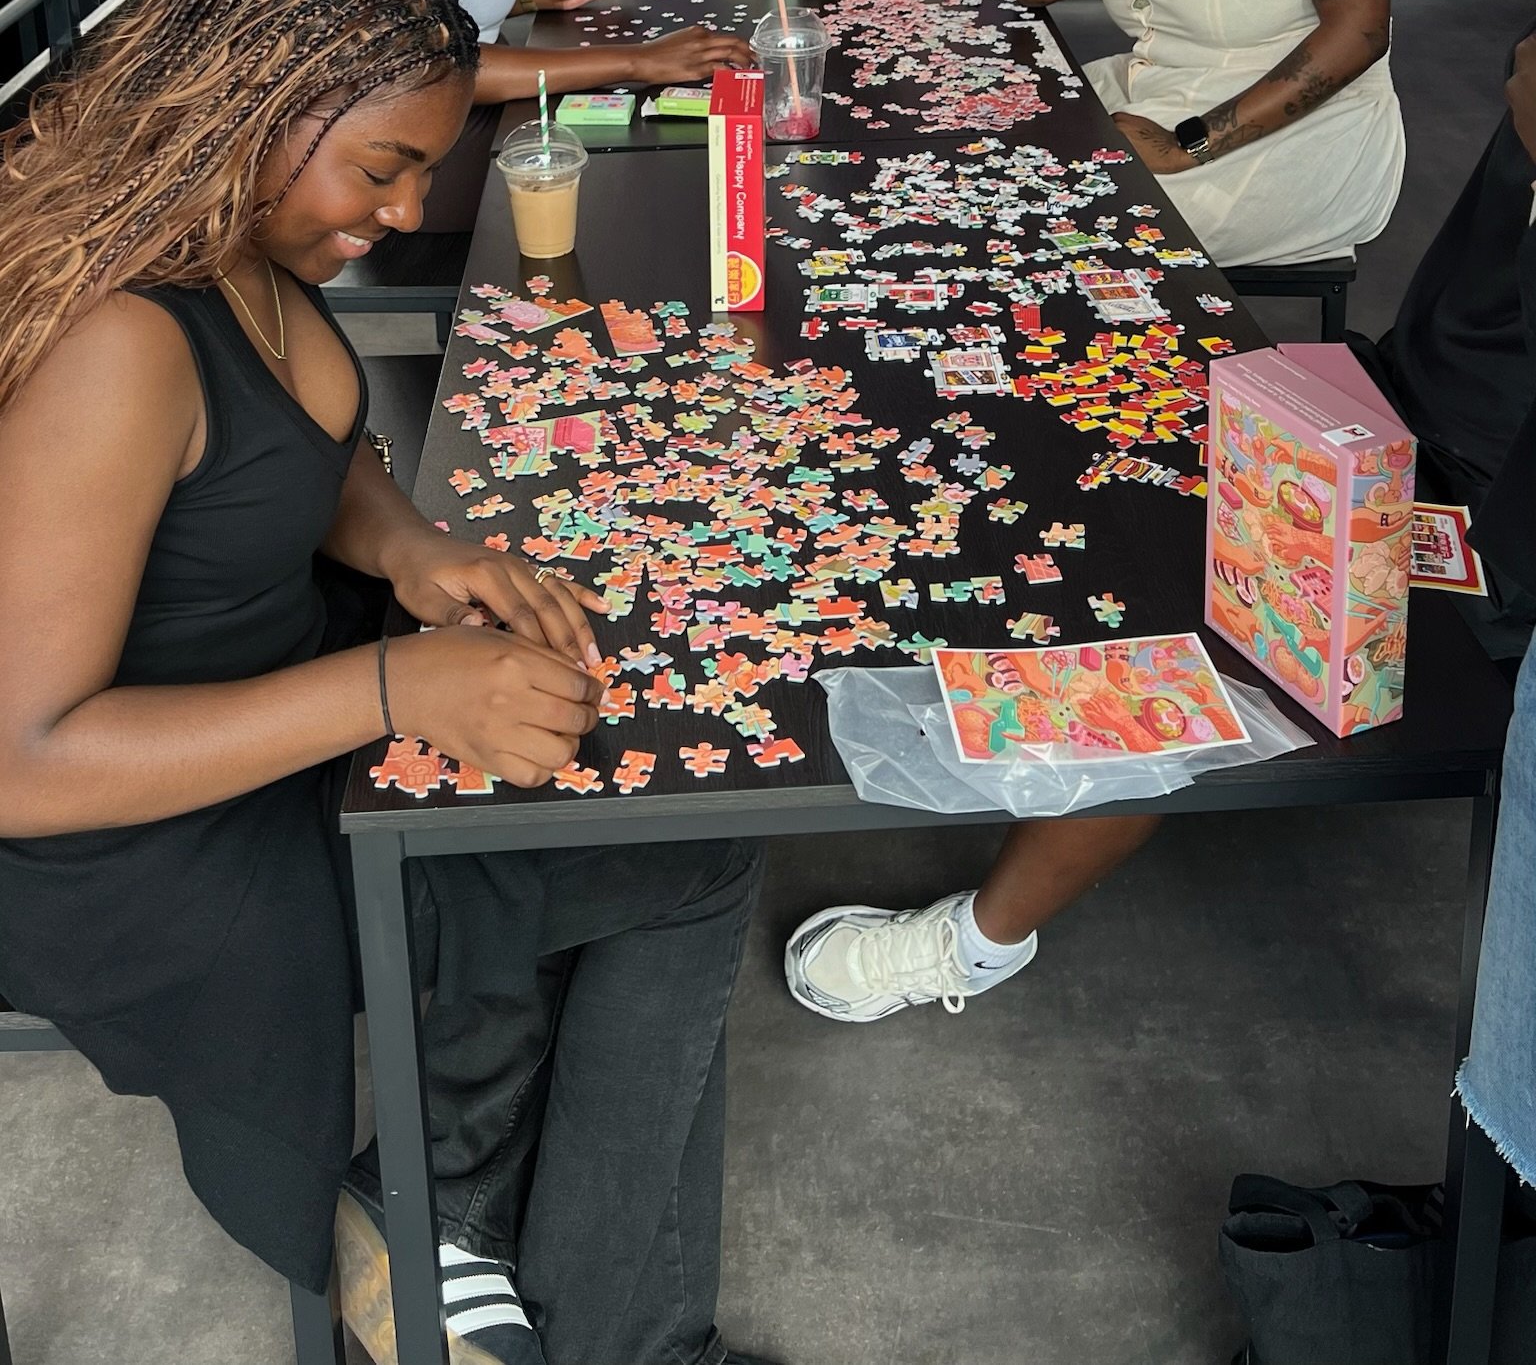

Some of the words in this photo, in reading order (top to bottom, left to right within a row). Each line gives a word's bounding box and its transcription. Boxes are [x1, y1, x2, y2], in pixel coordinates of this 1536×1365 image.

[735, 124, 746, 152] Make
[732, 155, 746, 189] Happy
[732, 192, 747, 240] Company
